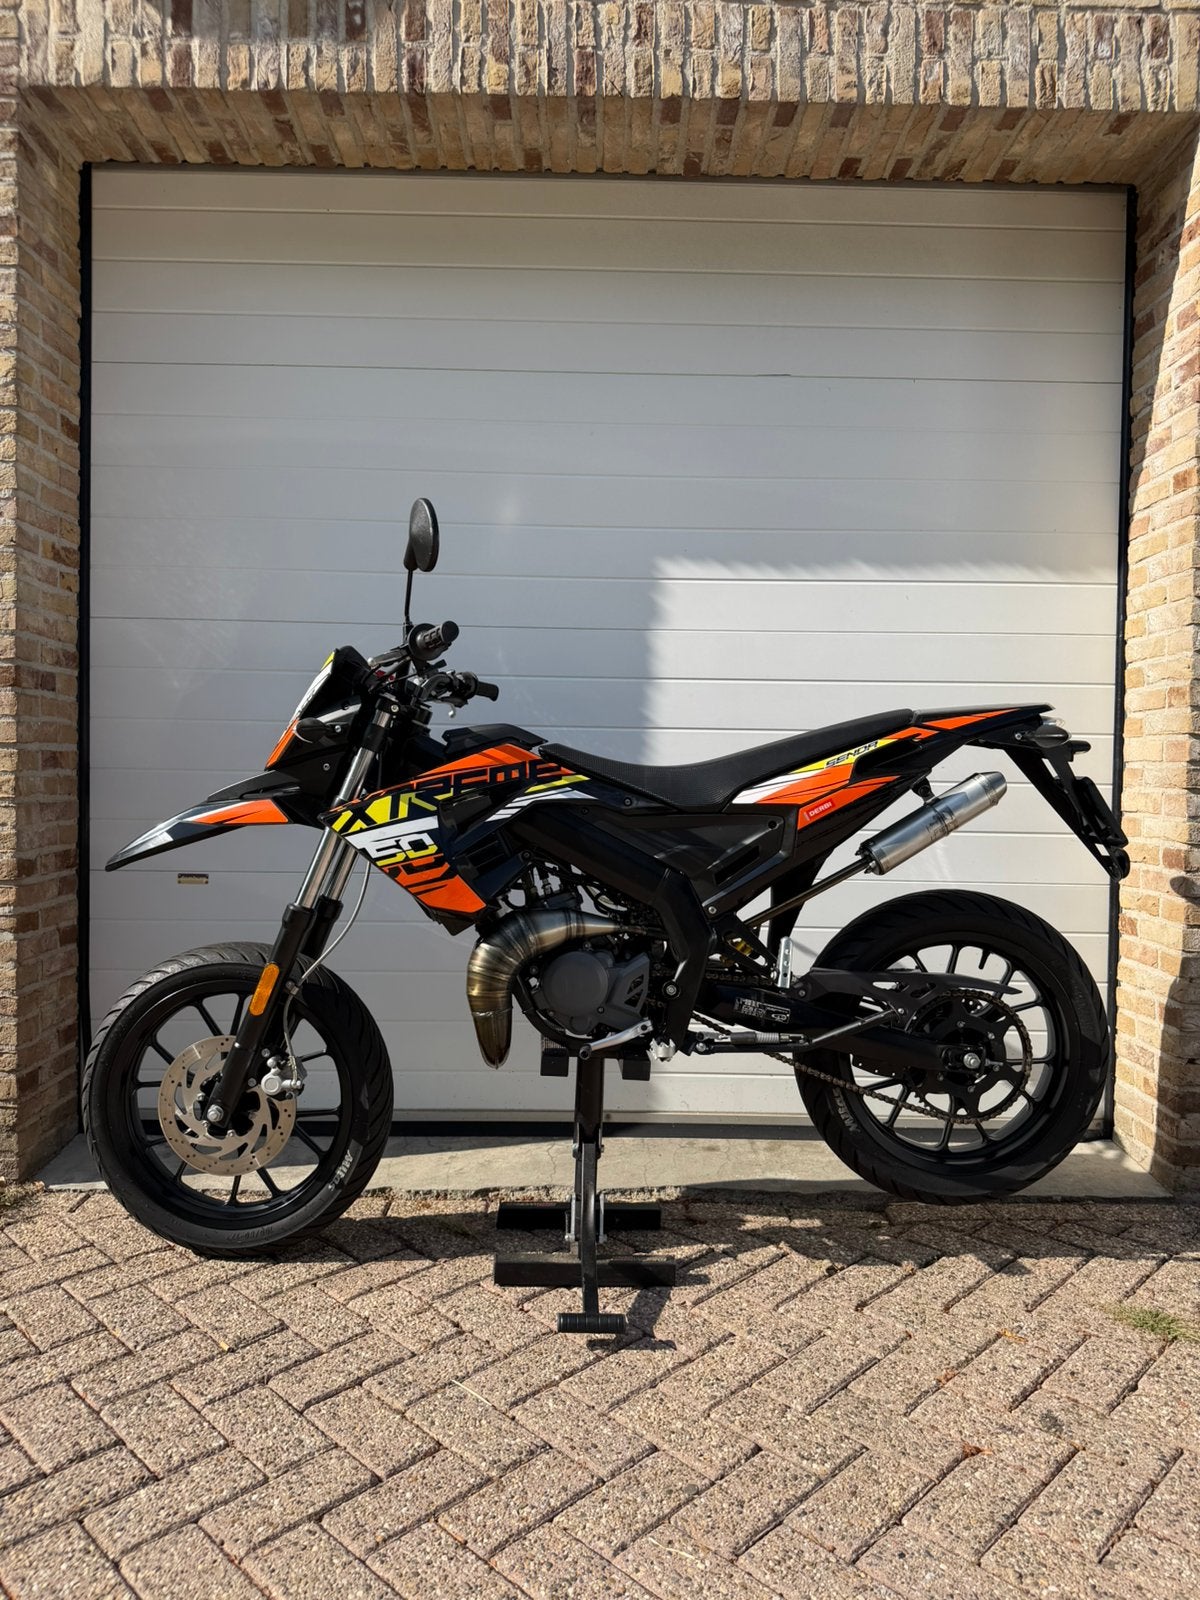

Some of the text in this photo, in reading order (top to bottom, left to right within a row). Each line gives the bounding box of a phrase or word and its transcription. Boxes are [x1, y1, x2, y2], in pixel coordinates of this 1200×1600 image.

[825, 740, 879, 768] SENDA
[808, 801, 833, 817] DERBI
[364, 832, 438, 866] 50
